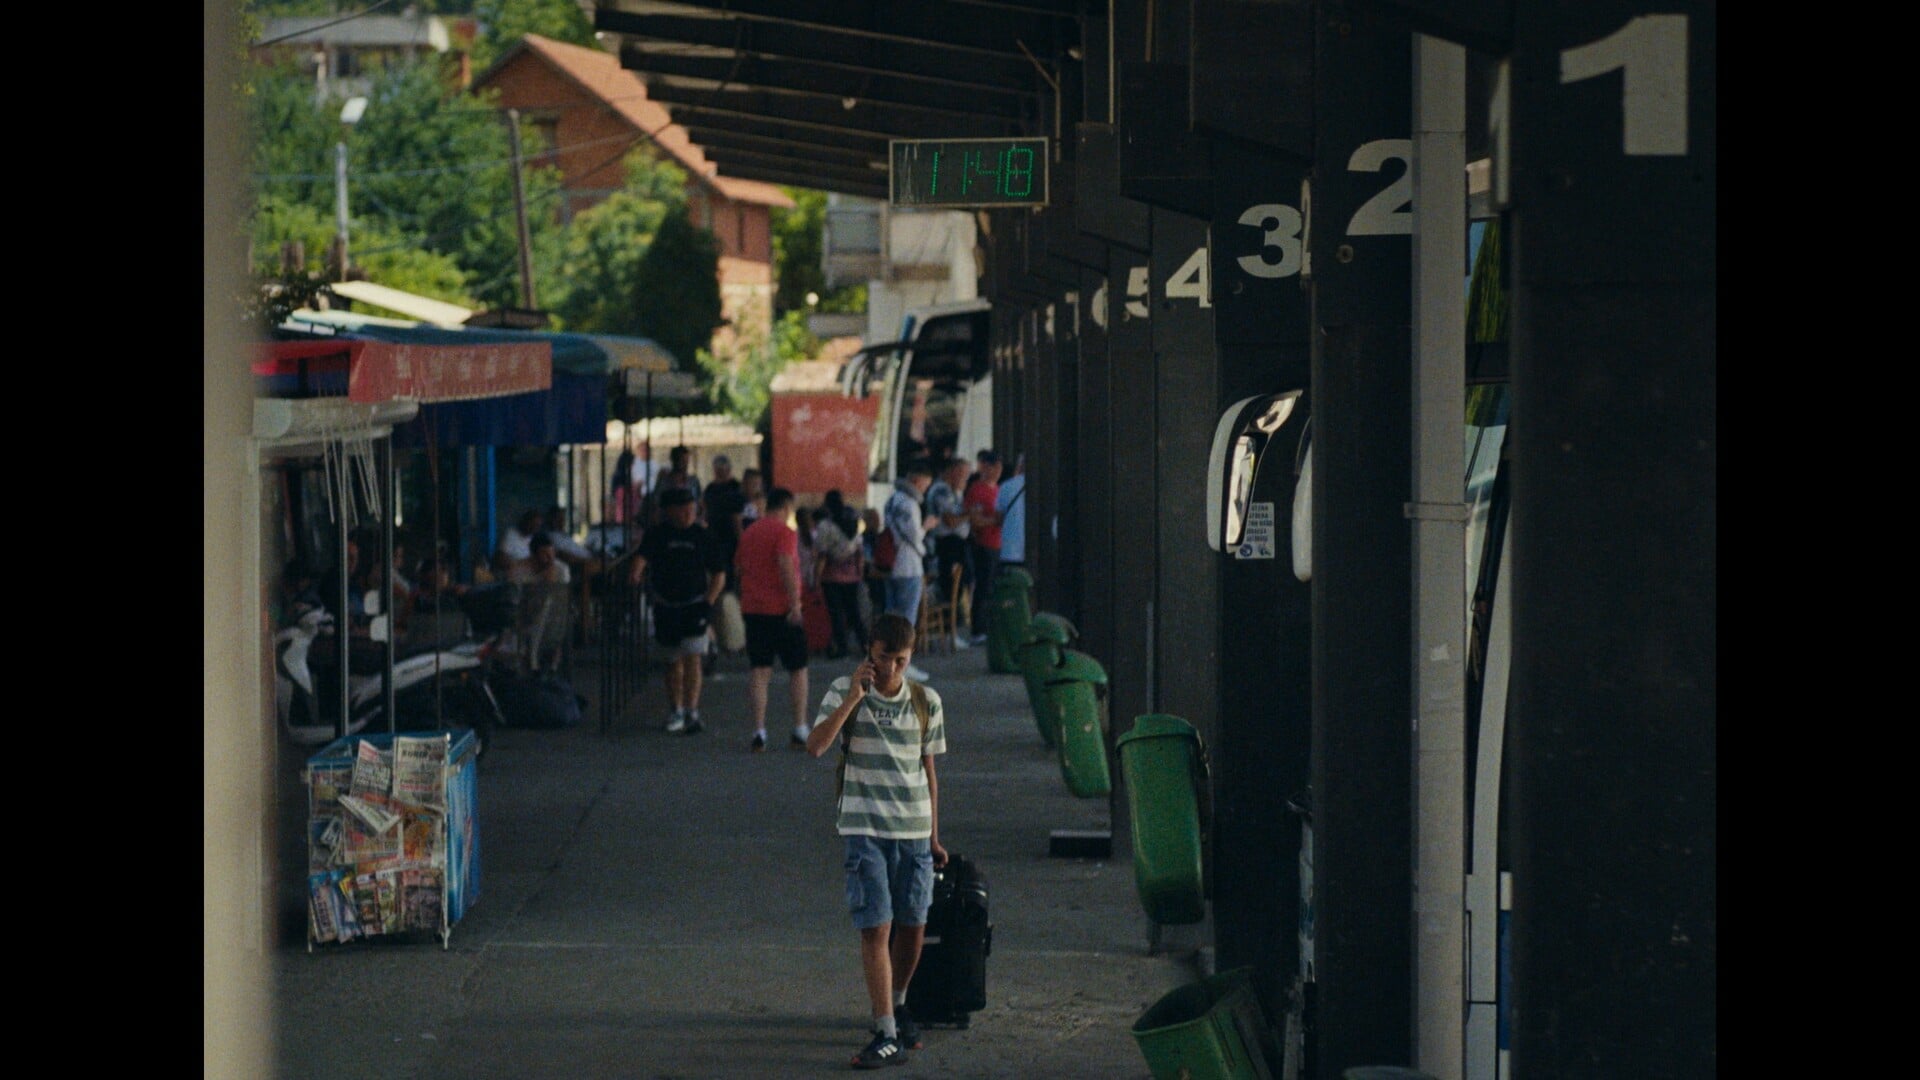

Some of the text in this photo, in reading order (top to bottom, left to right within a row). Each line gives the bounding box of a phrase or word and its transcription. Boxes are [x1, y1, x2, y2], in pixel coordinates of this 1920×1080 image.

[1560, 13, 1689, 156] 1
[932, 148, 1034, 197] 11:48
[1346, 138, 1413, 236] 2
[1166, 247, 1212, 308] 4
[1236, 203, 1302, 279] 3
